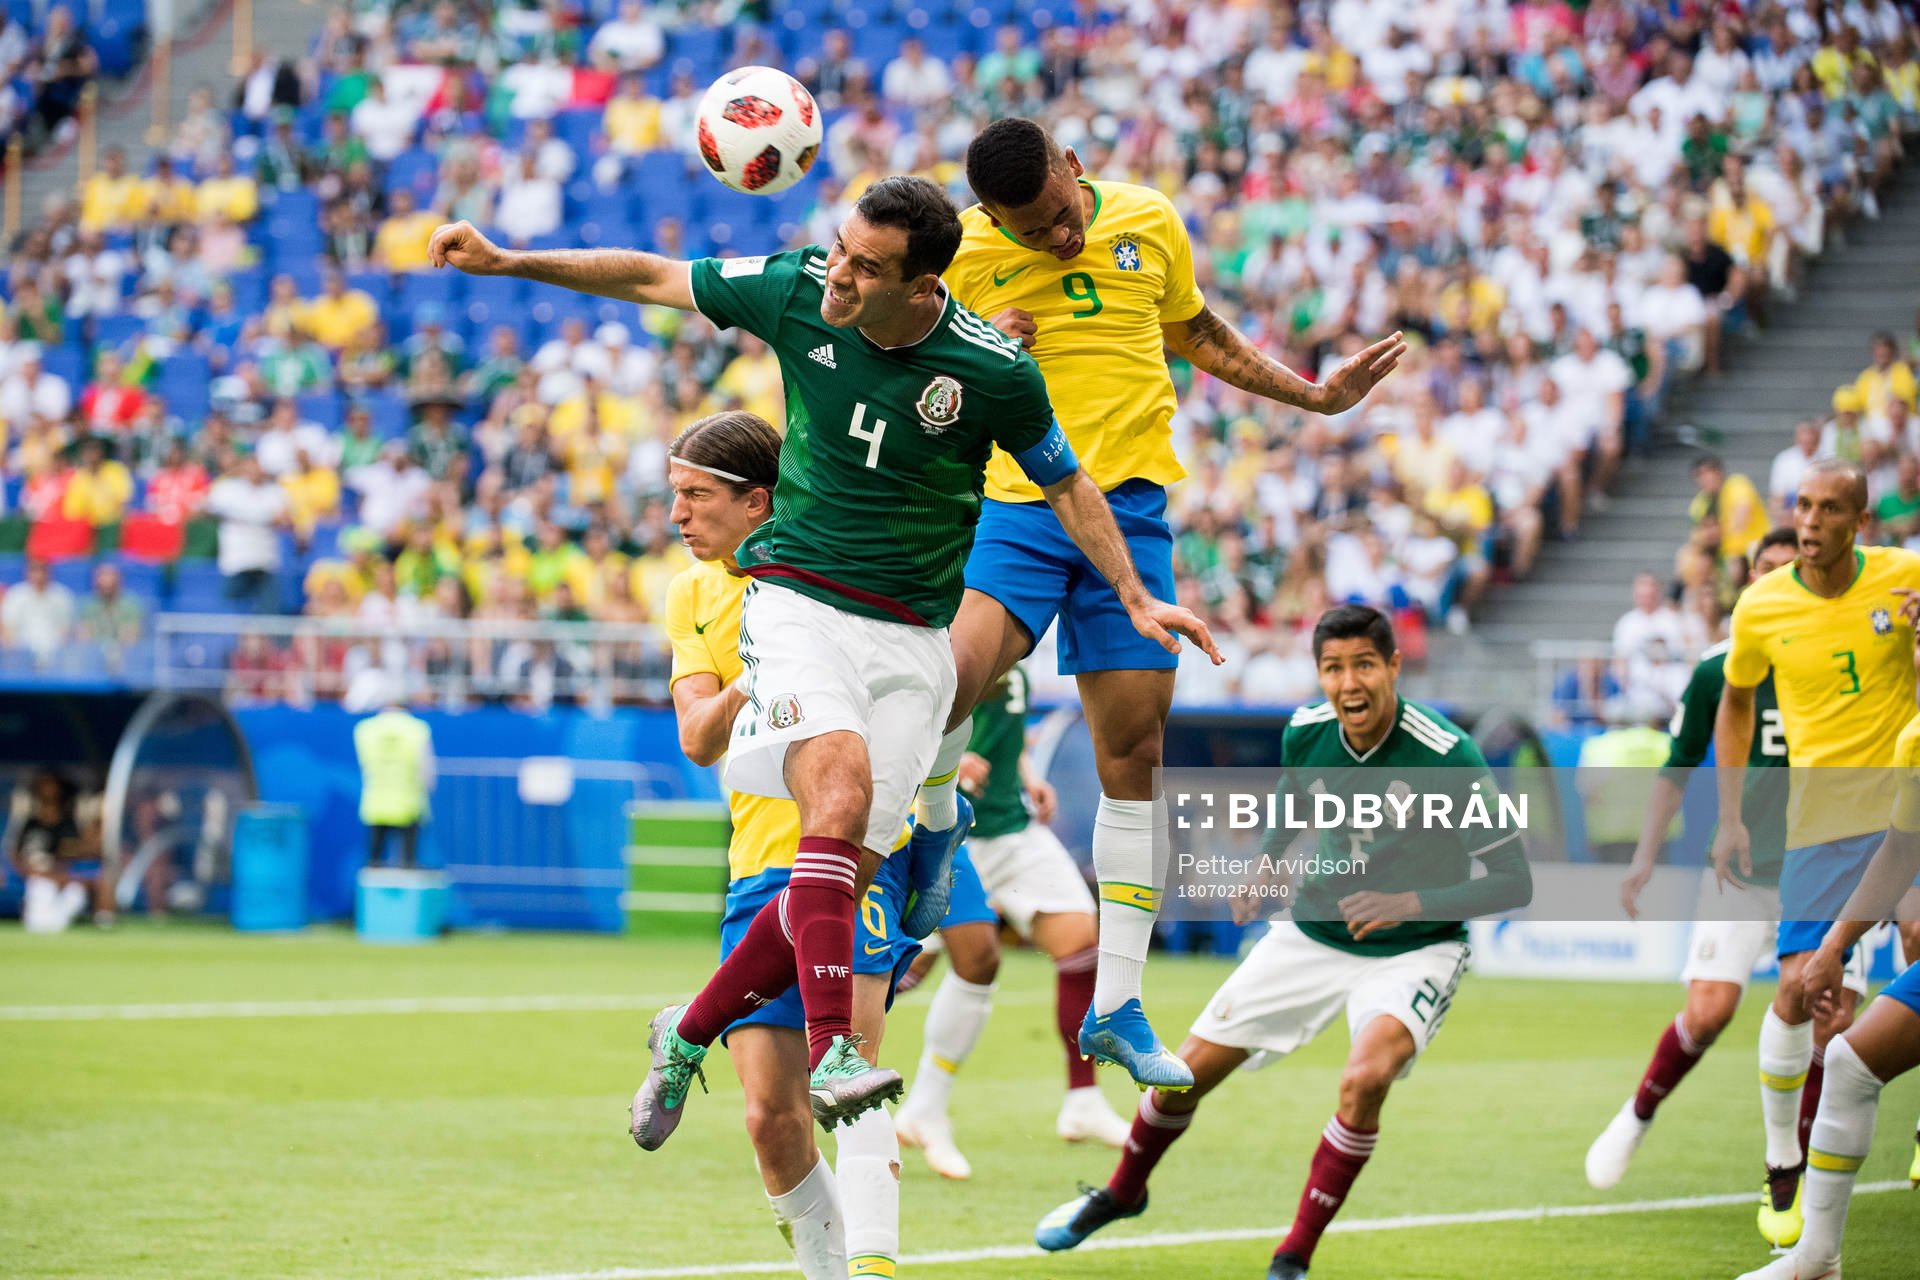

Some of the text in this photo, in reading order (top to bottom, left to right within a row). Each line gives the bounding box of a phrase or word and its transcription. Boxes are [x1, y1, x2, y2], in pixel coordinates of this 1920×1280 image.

[1062, 272, 1103, 319] 9
[808, 351, 837, 370] adidas
[848, 402, 887, 469] 4
[1832, 650, 1860, 694] 3
[861, 884, 887, 941] 6
[813, 965, 850, 979] FMF
[1411, 979, 1439, 1023] 2
